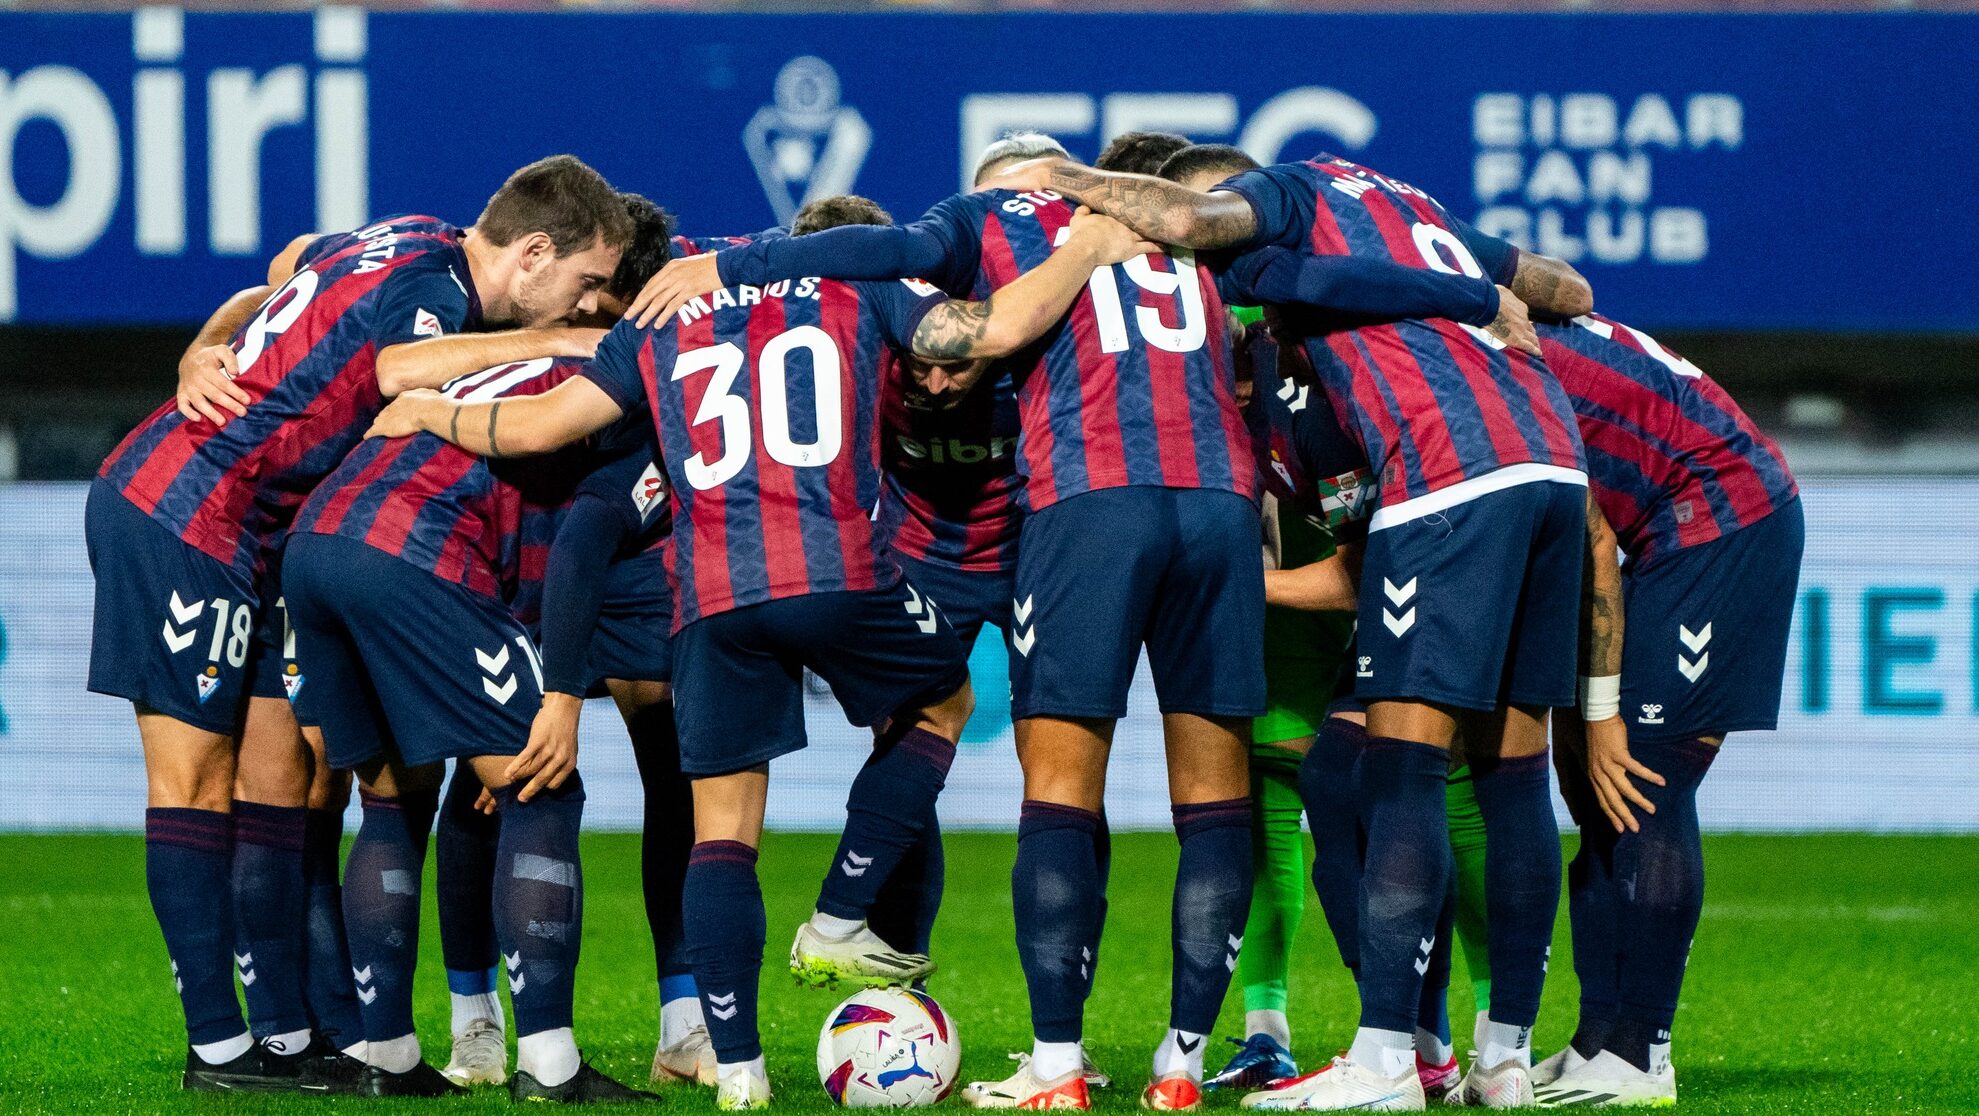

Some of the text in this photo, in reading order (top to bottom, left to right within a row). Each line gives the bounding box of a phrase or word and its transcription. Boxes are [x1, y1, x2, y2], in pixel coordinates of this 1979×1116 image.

[1473, 92, 1744, 149] EIBAR
[1473, 150, 1652, 203] FAN
[1474, 206, 1708, 264] CLUB
[670, 325, 842, 491] 30
[208, 597, 252, 668] 18
